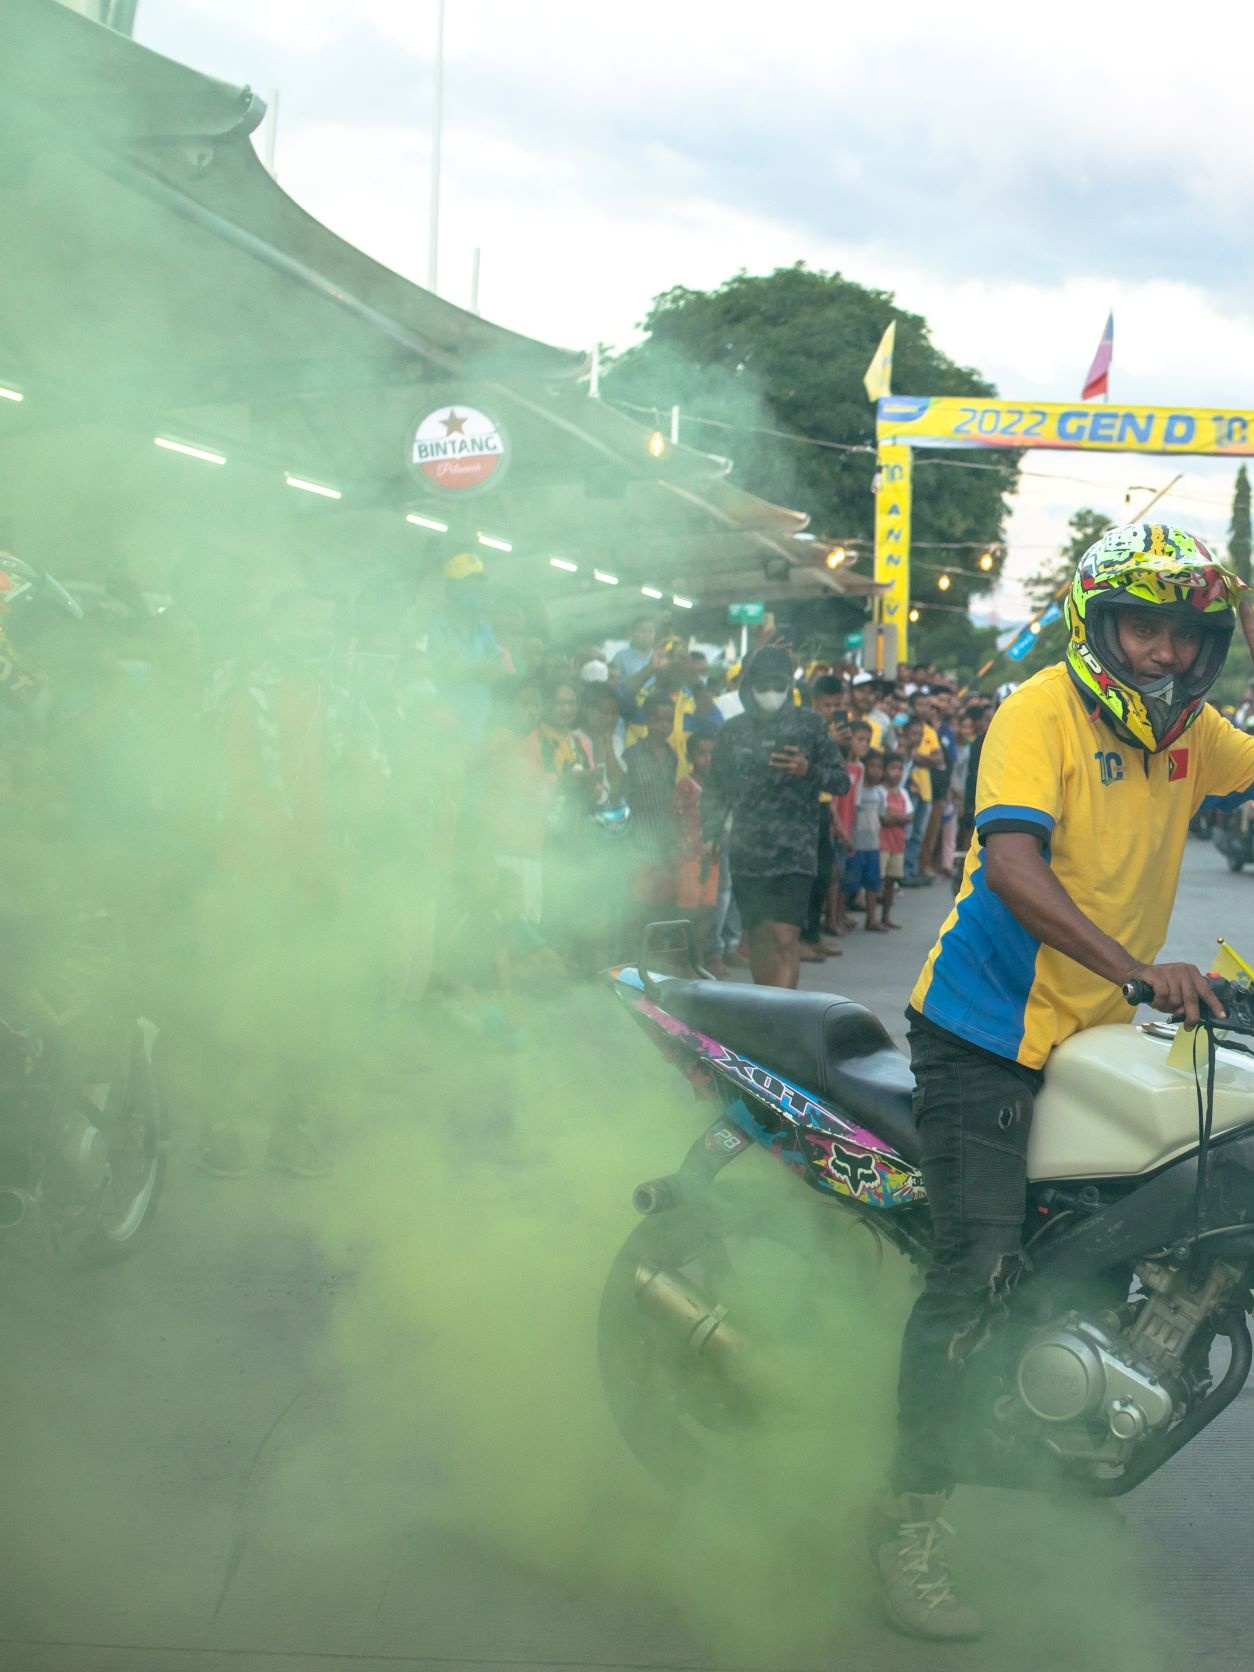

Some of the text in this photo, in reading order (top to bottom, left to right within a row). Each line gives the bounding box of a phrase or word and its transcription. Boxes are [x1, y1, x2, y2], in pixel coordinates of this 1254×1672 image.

[953, 407, 1048, 436] 2022
[1057, 410, 1155, 444] GEN
[418, 436, 497, 459] BINTANG
